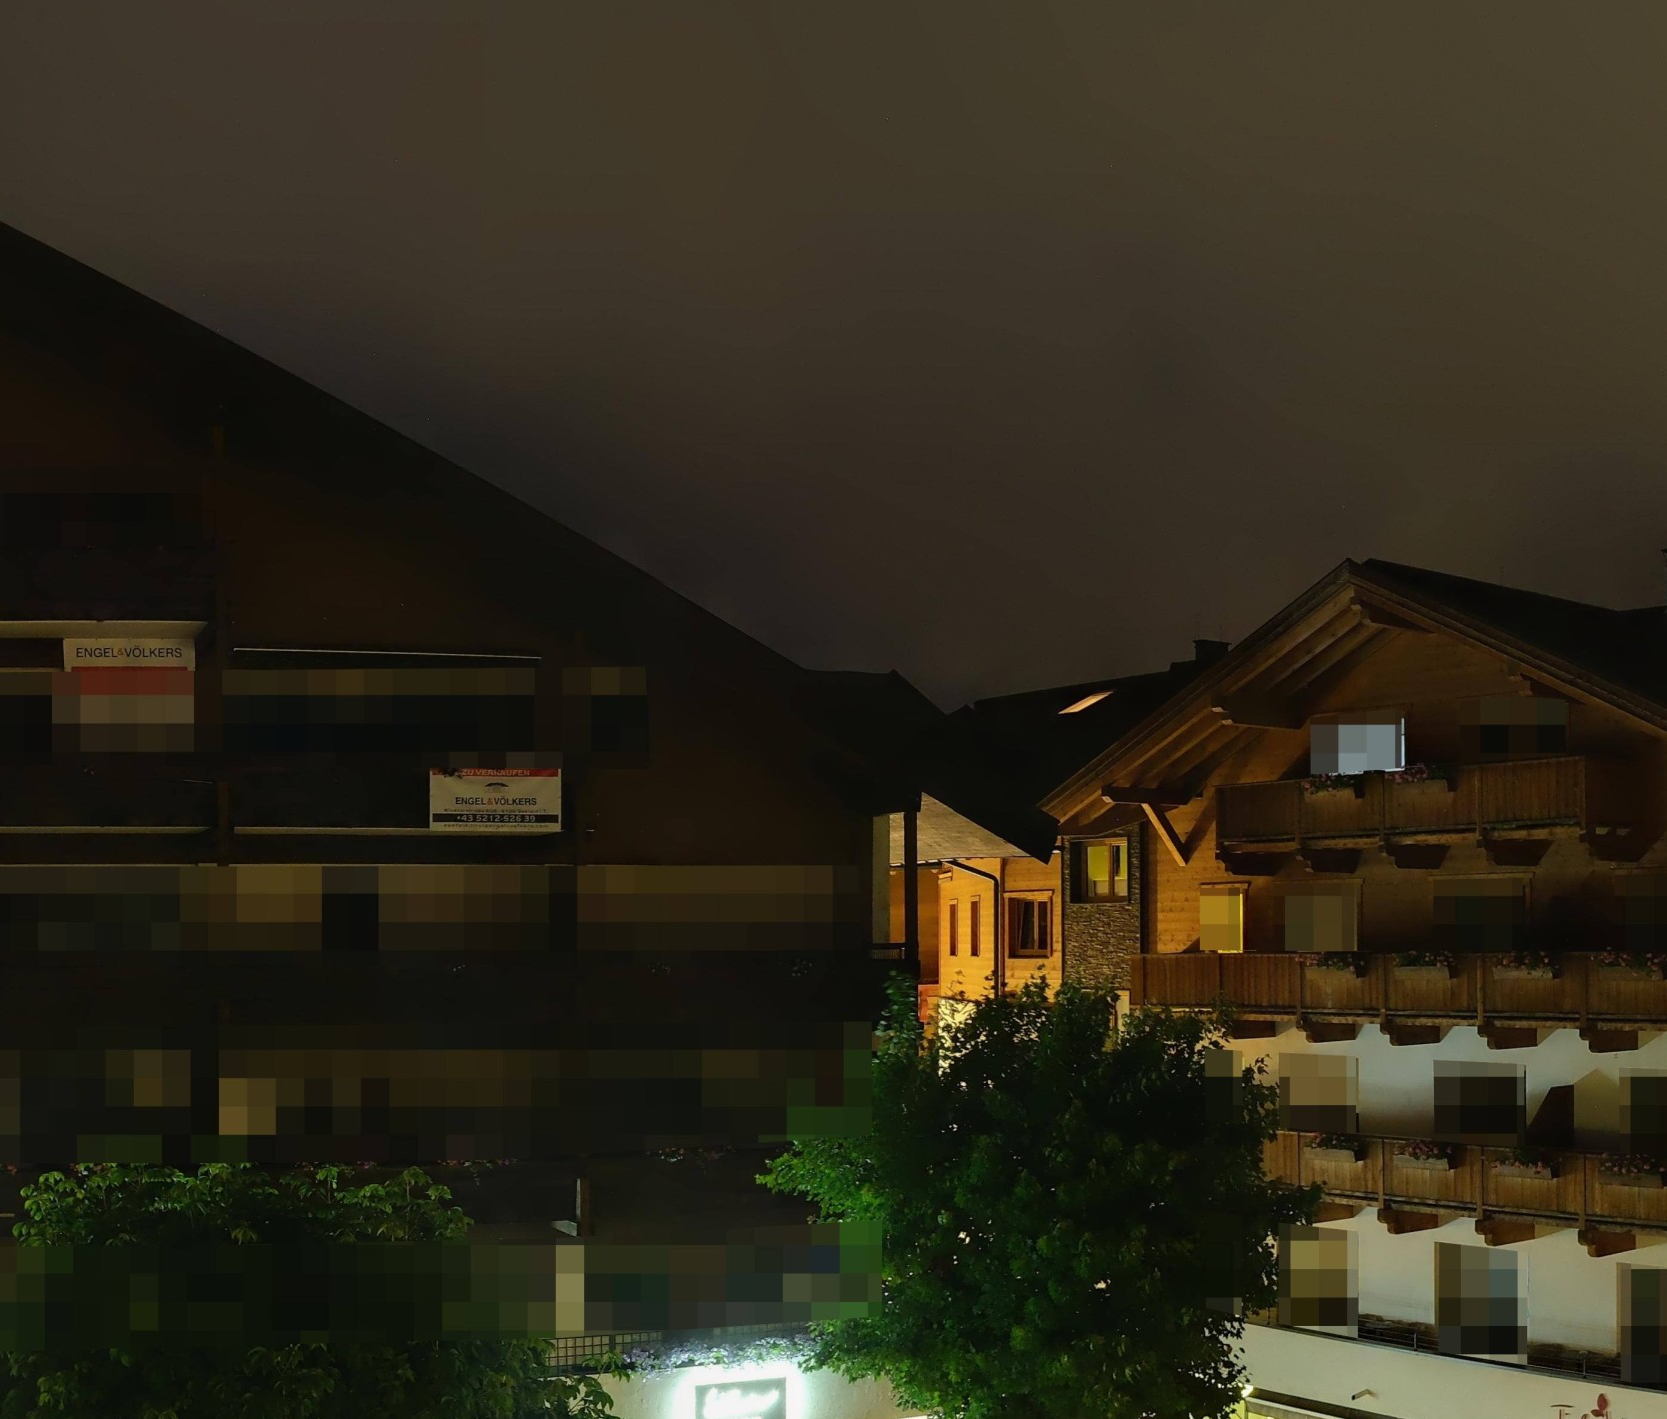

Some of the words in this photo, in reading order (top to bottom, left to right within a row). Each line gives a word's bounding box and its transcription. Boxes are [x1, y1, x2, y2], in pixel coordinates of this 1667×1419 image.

[76, 645, 183, 658] ENGEL&VÖLKERS
[475, 768, 531, 776] VERKAUFEN
[455, 796, 537, 806] ENGEL&VÖLKERS
